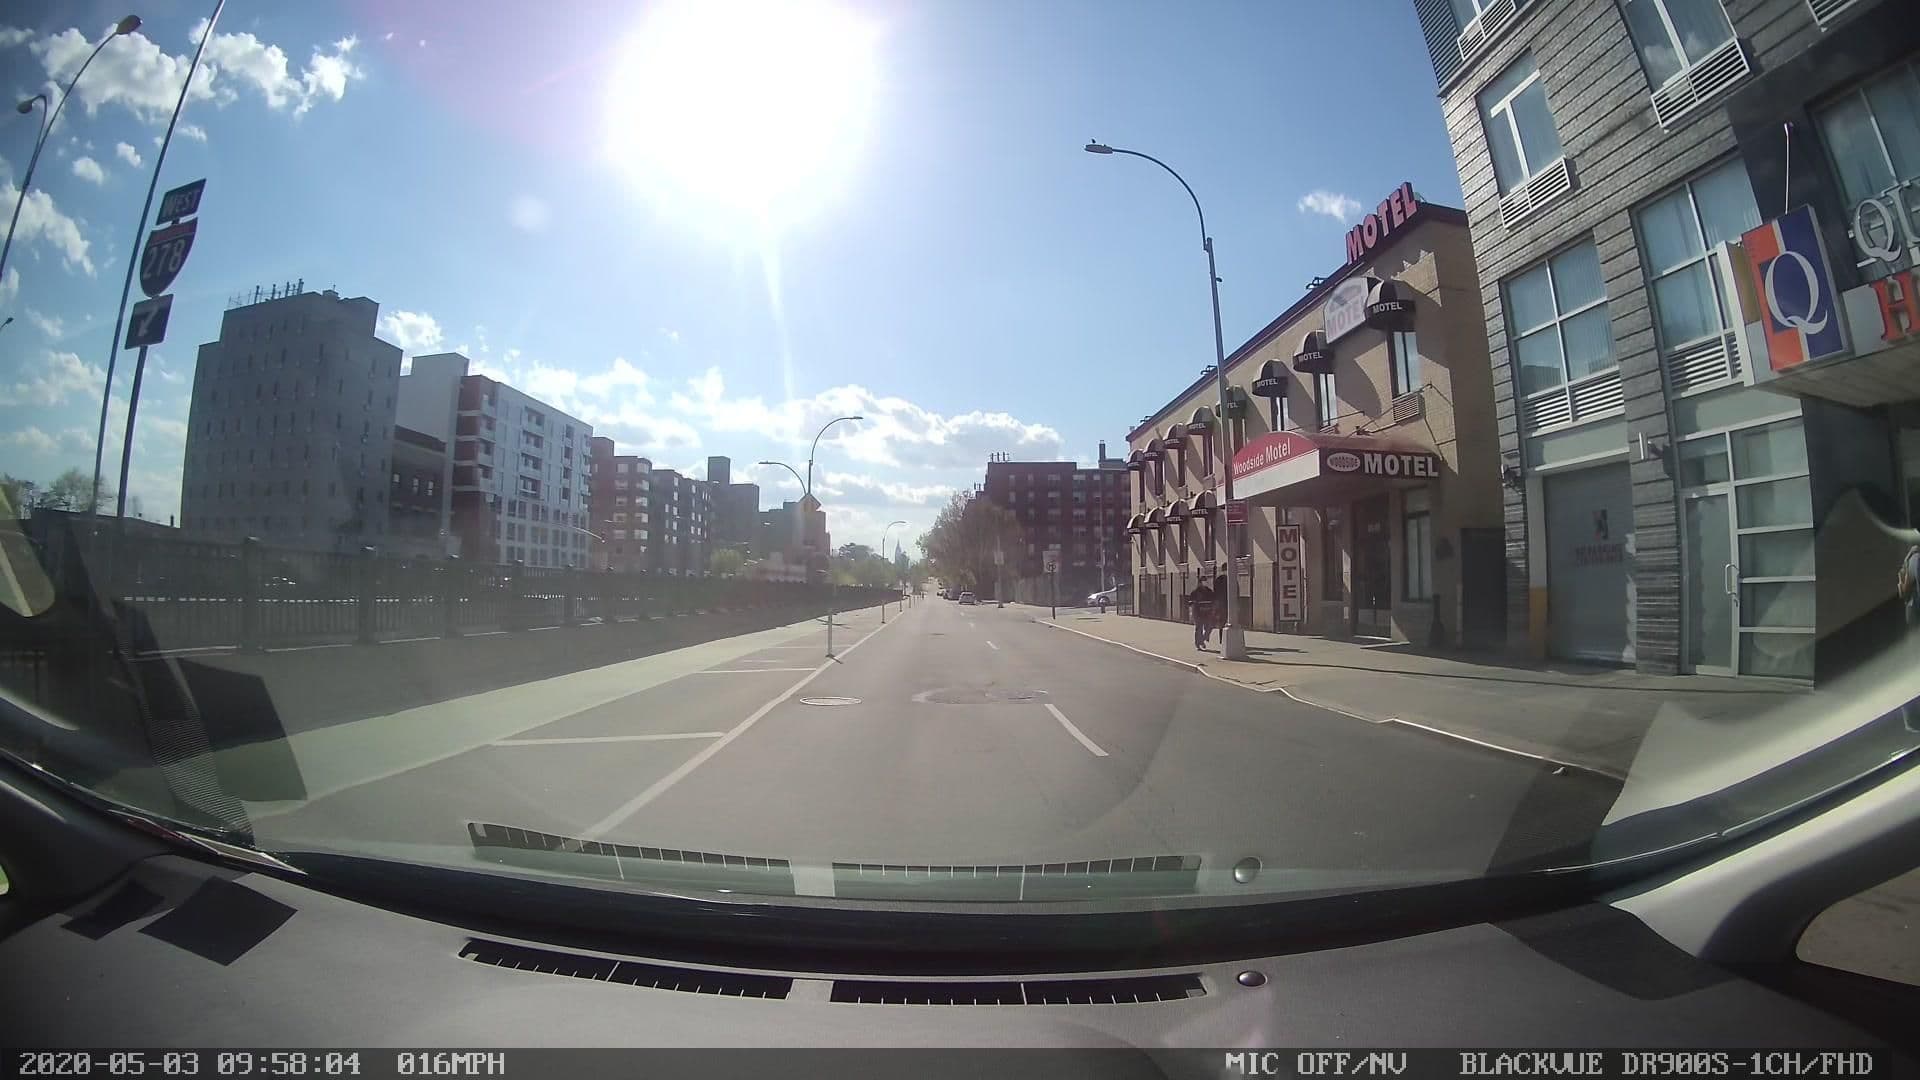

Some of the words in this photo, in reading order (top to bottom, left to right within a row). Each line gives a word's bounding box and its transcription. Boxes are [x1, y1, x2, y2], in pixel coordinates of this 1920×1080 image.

[162, 189, 200, 215] WEST
[1346, 182, 1418, 265] MOTEL
[143, 239, 187, 279] 278
[1372, 302, 1402, 313] MOTEL
[1764, 250, 1828, 335] Q
[1233, 453, 1264, 475] Woodside
[1265, 437, 1291, 463] Motel
[1363, 453, 1439, 477] MOTEL
[1279, 528, 1297, 618] MOTEL
